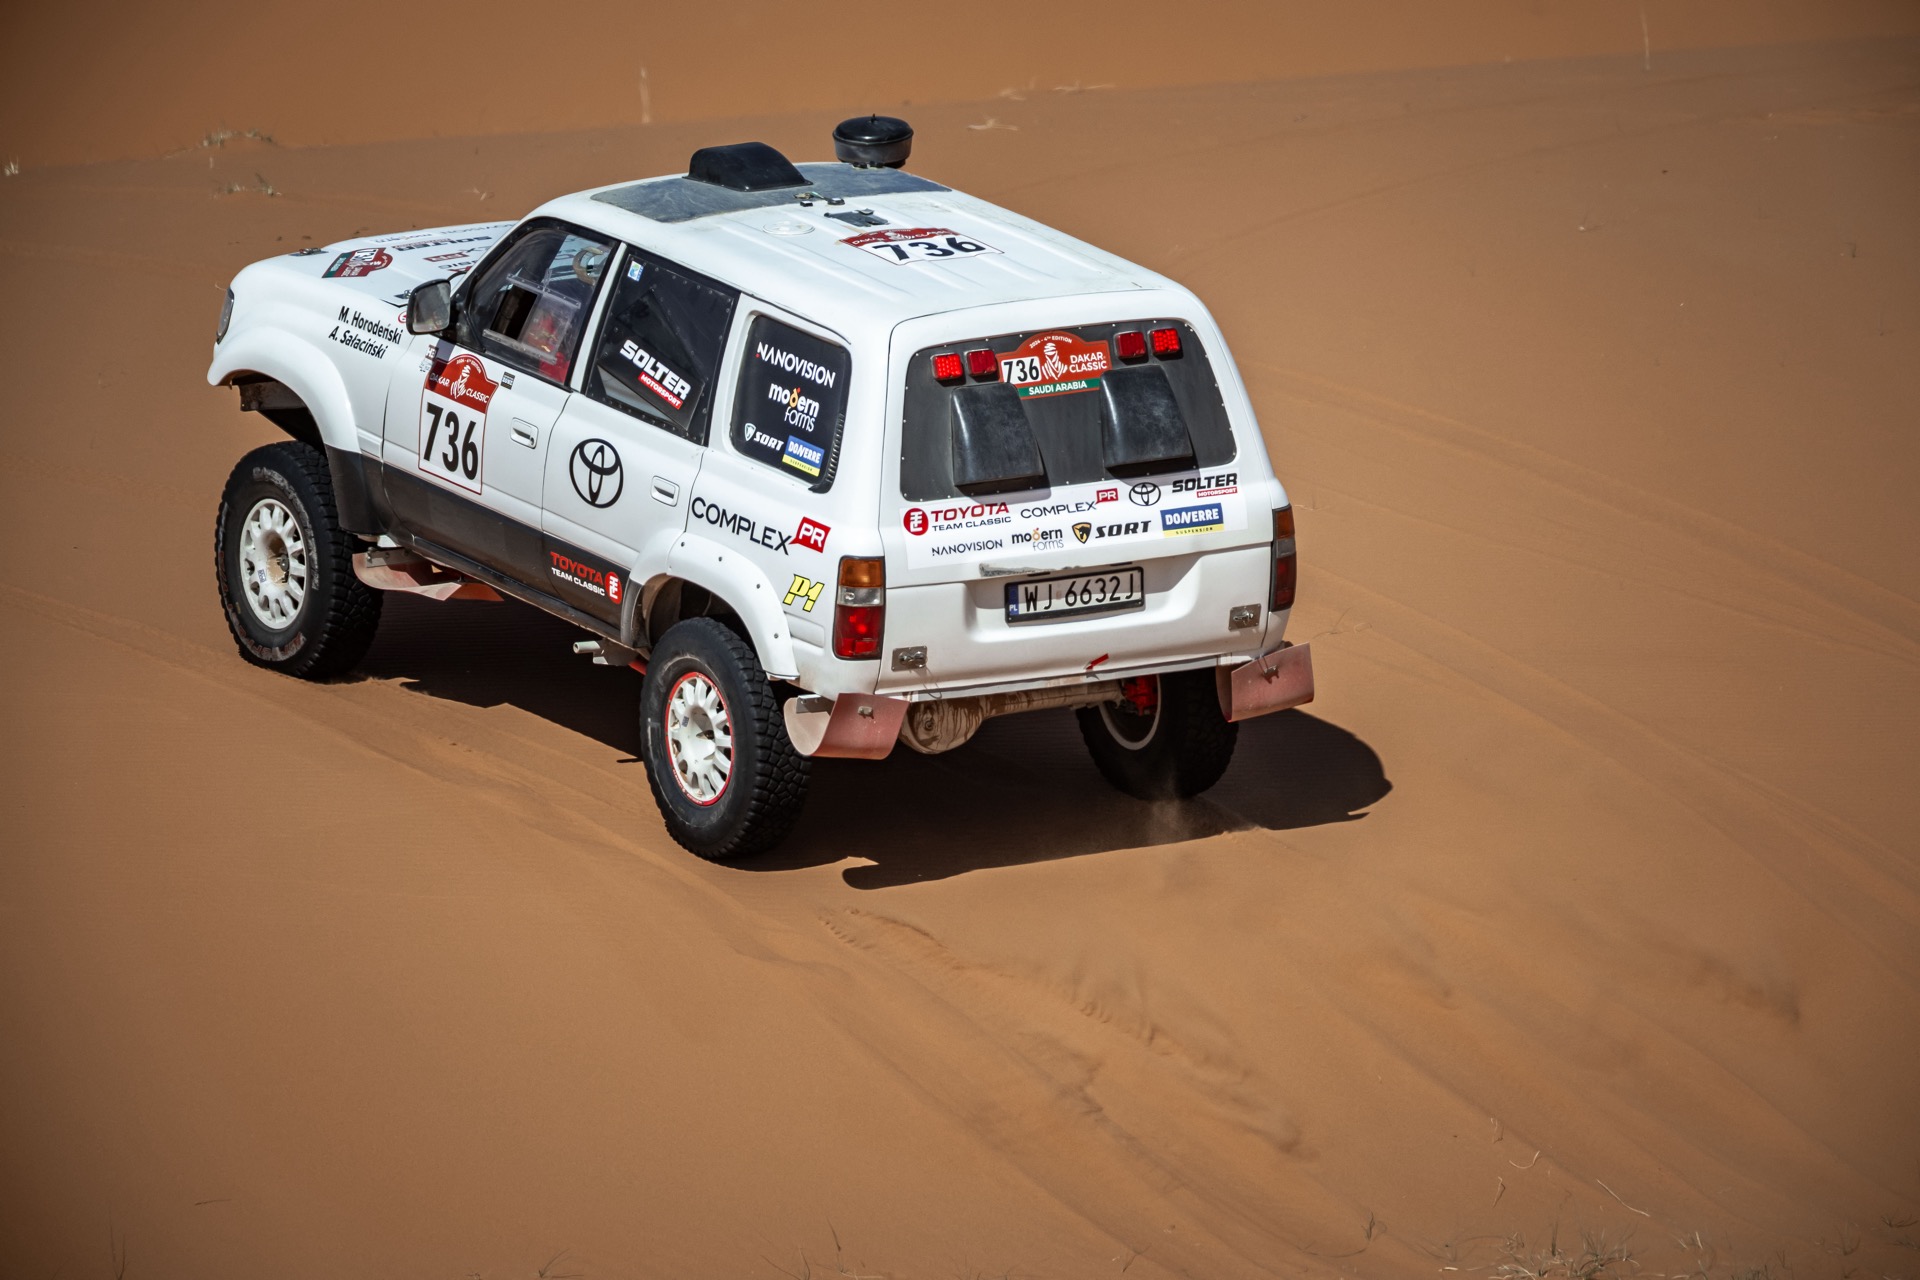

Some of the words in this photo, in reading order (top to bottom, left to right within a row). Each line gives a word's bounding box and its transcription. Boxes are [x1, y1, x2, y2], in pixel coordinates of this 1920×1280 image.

[872, 237, 986, 261] 736
[338, 305, 350, 324] M.
[351, 310, 403, 345] Horodeński
[328, 326, 339, 341] A.
[340, 329, 389, 359] Sałaciński
[1052, 335, 1072, 344] EDITION
[620, 339, 691, 400] SOLTER
[755, 341, 836, 388] NANOVISION
[1069, 360, 1107, 373] CLASSIC
[1070, 351, 1104, 364] DAKAR
[1003, 358, 1040, 383] 736
[429, 372, 450, 387] DAKAR
[466, 388, 490, 403] CLASSIC
[641, 374, 680, 407] MOTORSPORT
[1028, 385, 1054, 396] SAUDI
[1055, 380, 1087, 392] ARABIA
[784, 406, 816, 432] forms
[423, 401, 479, 480] 736
[754, 431, 784, 451] SORT
[788, 441, 821, 464] DONERRE
[1172, 473, 1237, 493] SOLTER
[1197, 487, 1237, 498] MOTORSPORT
[931, 502, 1010, 522] TOYOTA
[1020, 502, 1096, 519] COMPLEX
[1098, 490, 1117, 501] PR
[692, 497, 792, 556] COMPLEX
[932, 521, 963, 532] TEAM
[965, 516, 1012, 528] CLASSIC
[1165, 508, 1220, 526] DONERRE
[799, 522, 825, 547] PR
[1095, 520, 1151, 539] SORT
[1176, 526, 1214, 536] SUSPENSION
[931, 539, 1003, 557] NANOVISION
[549, 551, 604, 585] TOYOTA
[551, 567, 573, 582] TEAM
[574, 577, 606, 596] CLASSIC
[782, 574, 825, 612] P1
[1024, 583, 1053, 612] WJ
[1064, 573, 1134, 607] 6632J
[1009, 604, 1018, 612] PL
